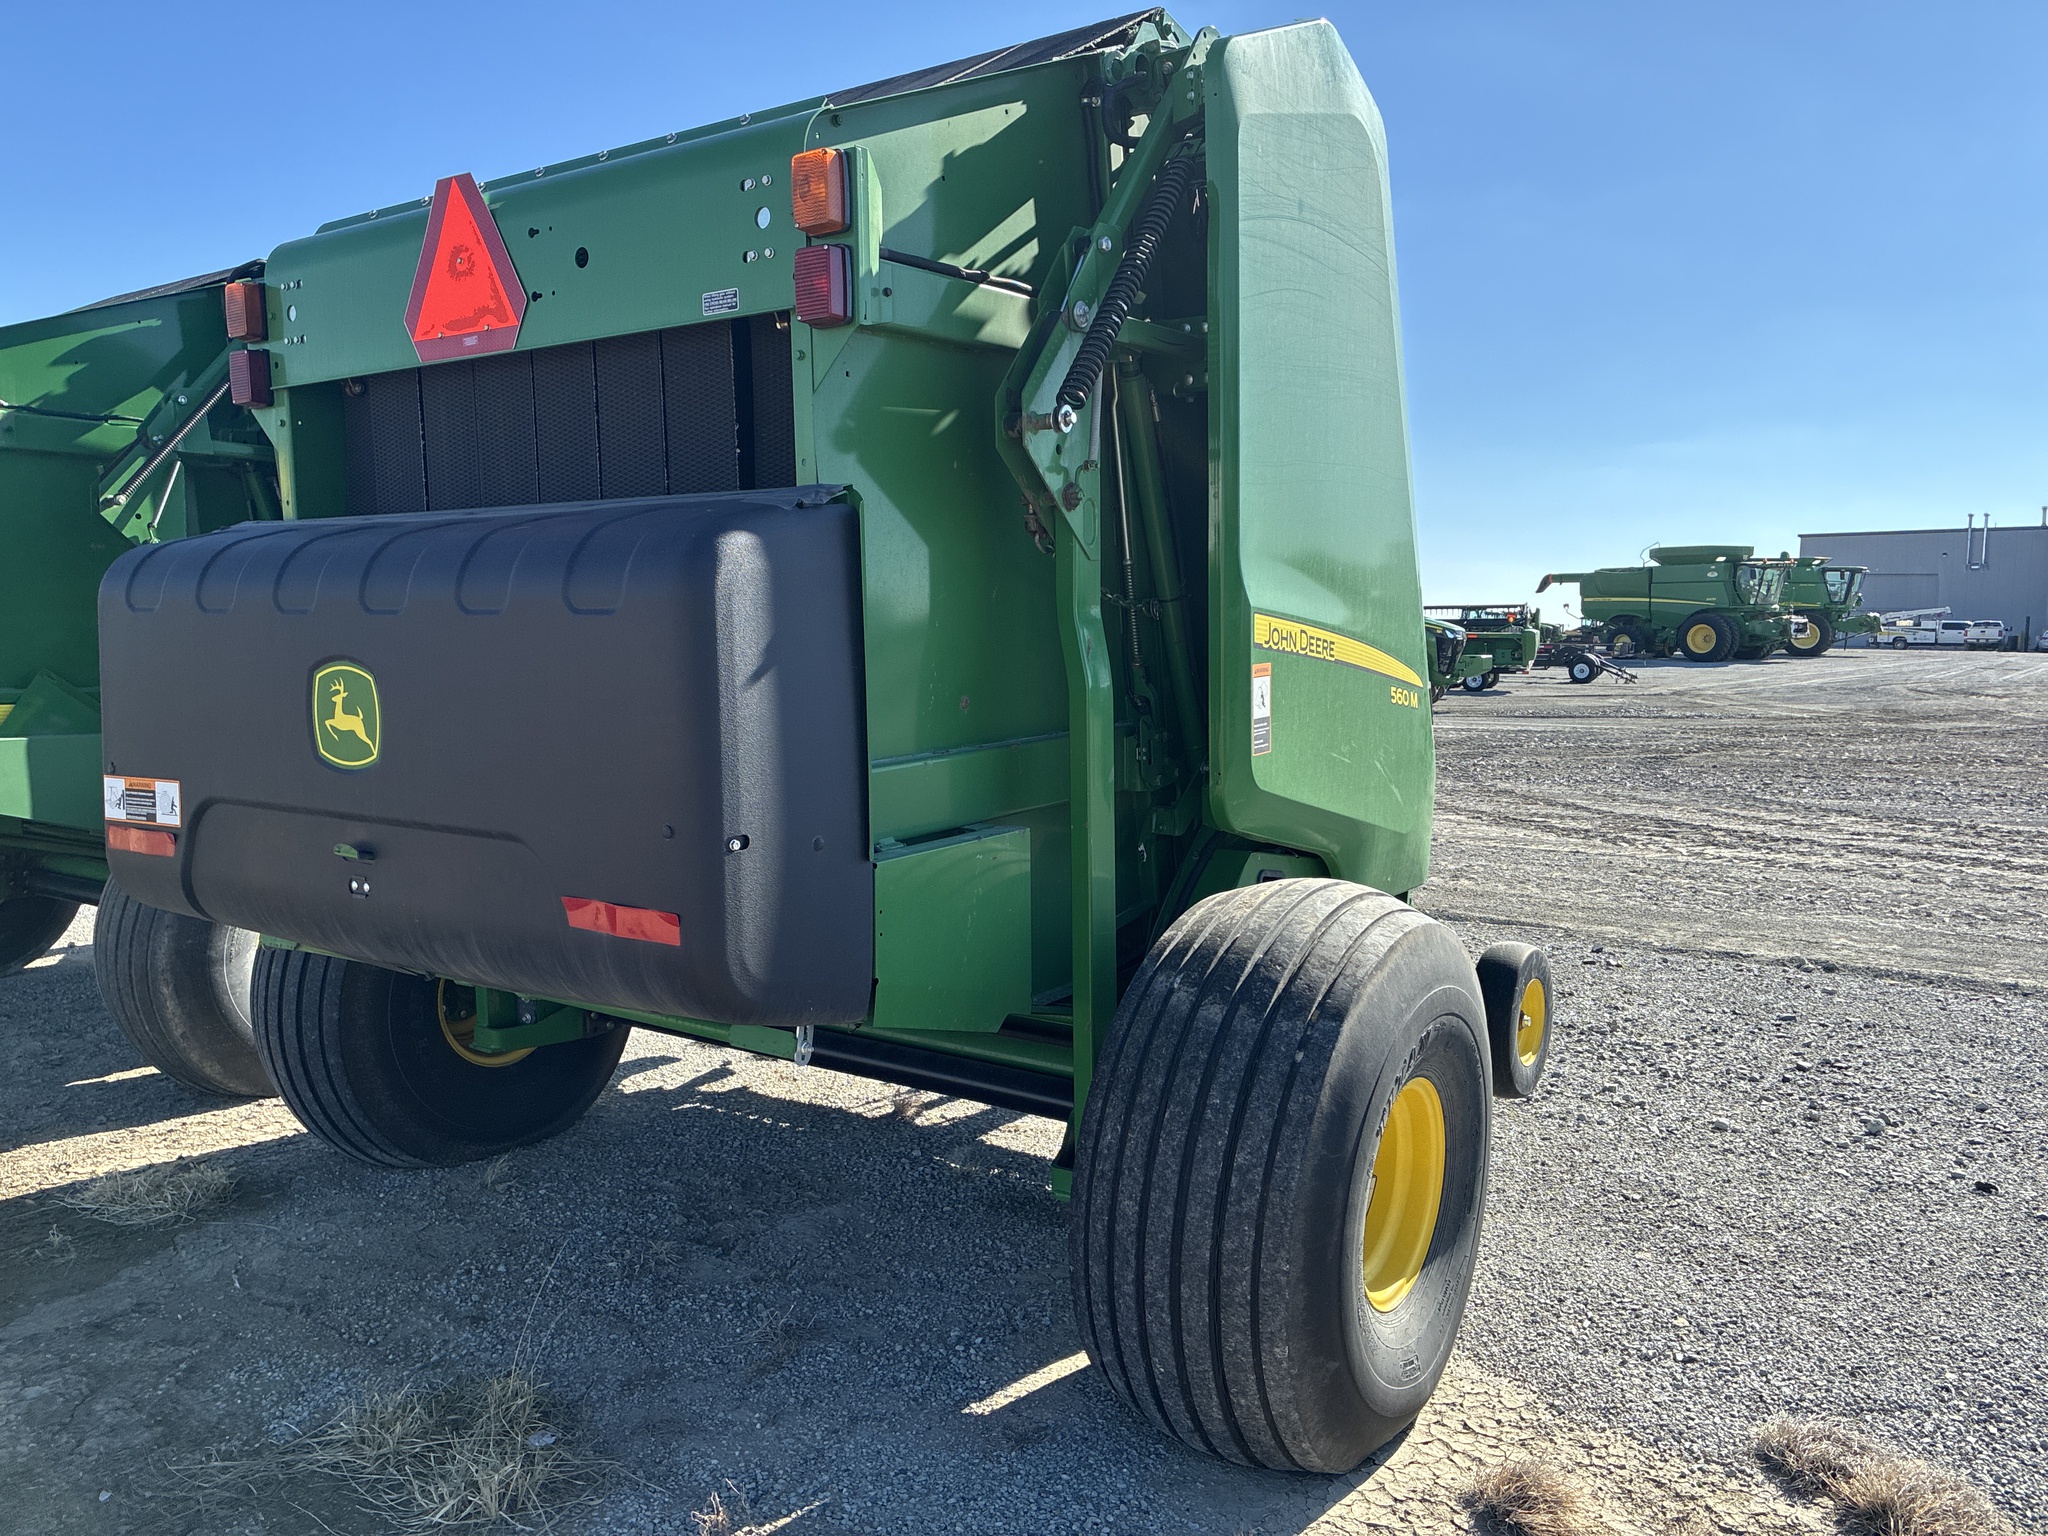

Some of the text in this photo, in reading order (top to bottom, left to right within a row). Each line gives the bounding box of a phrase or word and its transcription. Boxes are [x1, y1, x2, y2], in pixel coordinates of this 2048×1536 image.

[1264, 623, 1335, 659] JOHN DEERE
[1390, 686, 1419, 709] 560 M
